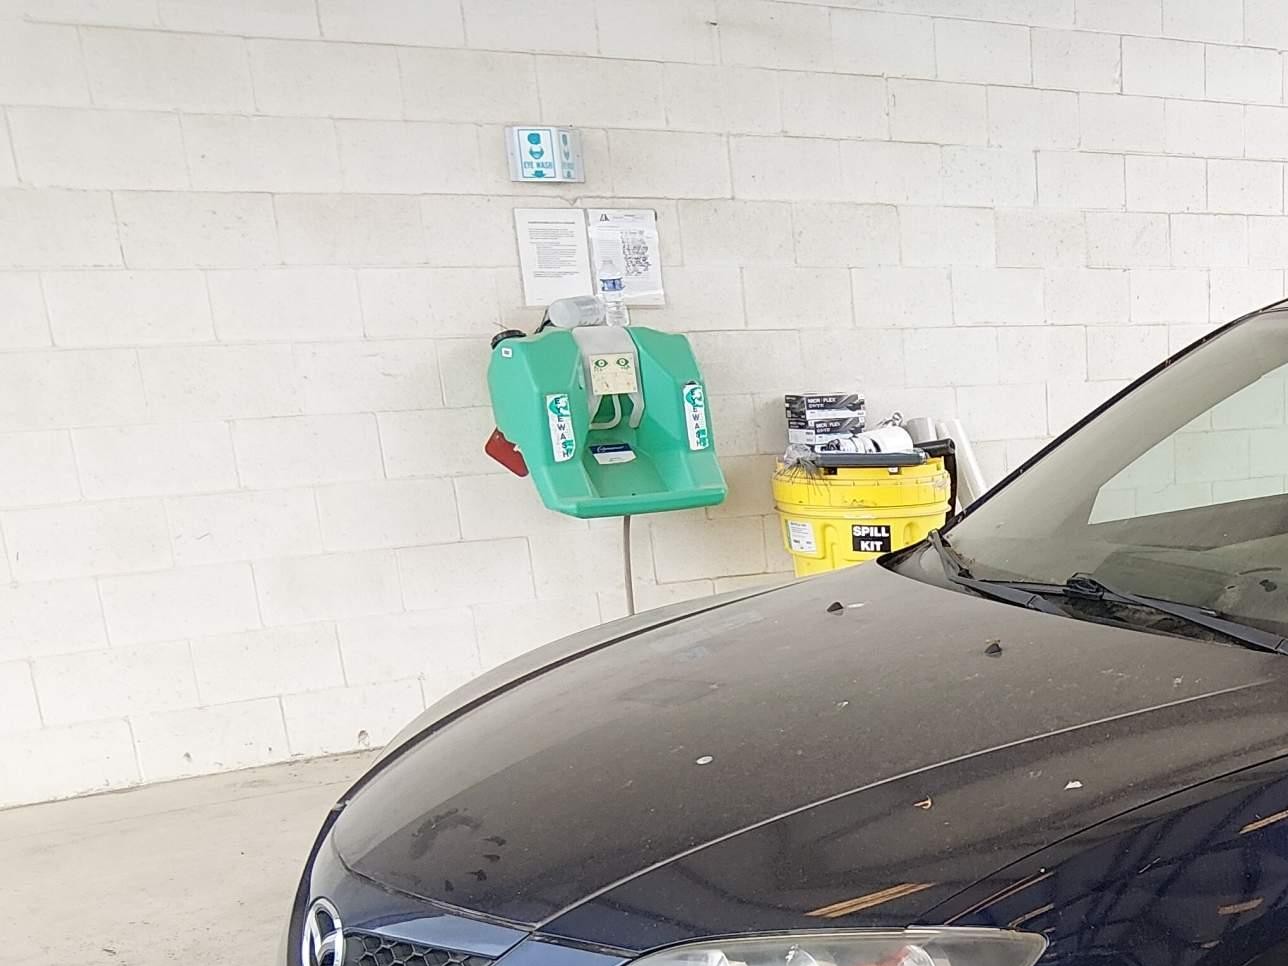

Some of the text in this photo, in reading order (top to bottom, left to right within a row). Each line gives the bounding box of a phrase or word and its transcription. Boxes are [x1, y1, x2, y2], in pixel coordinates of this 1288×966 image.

[523, 161, 533, 169] EYE
[536, 161, 553, 169] WASH
[852, 526, 890, 537] SPILL
[860, 540, 883, 551] KIT
